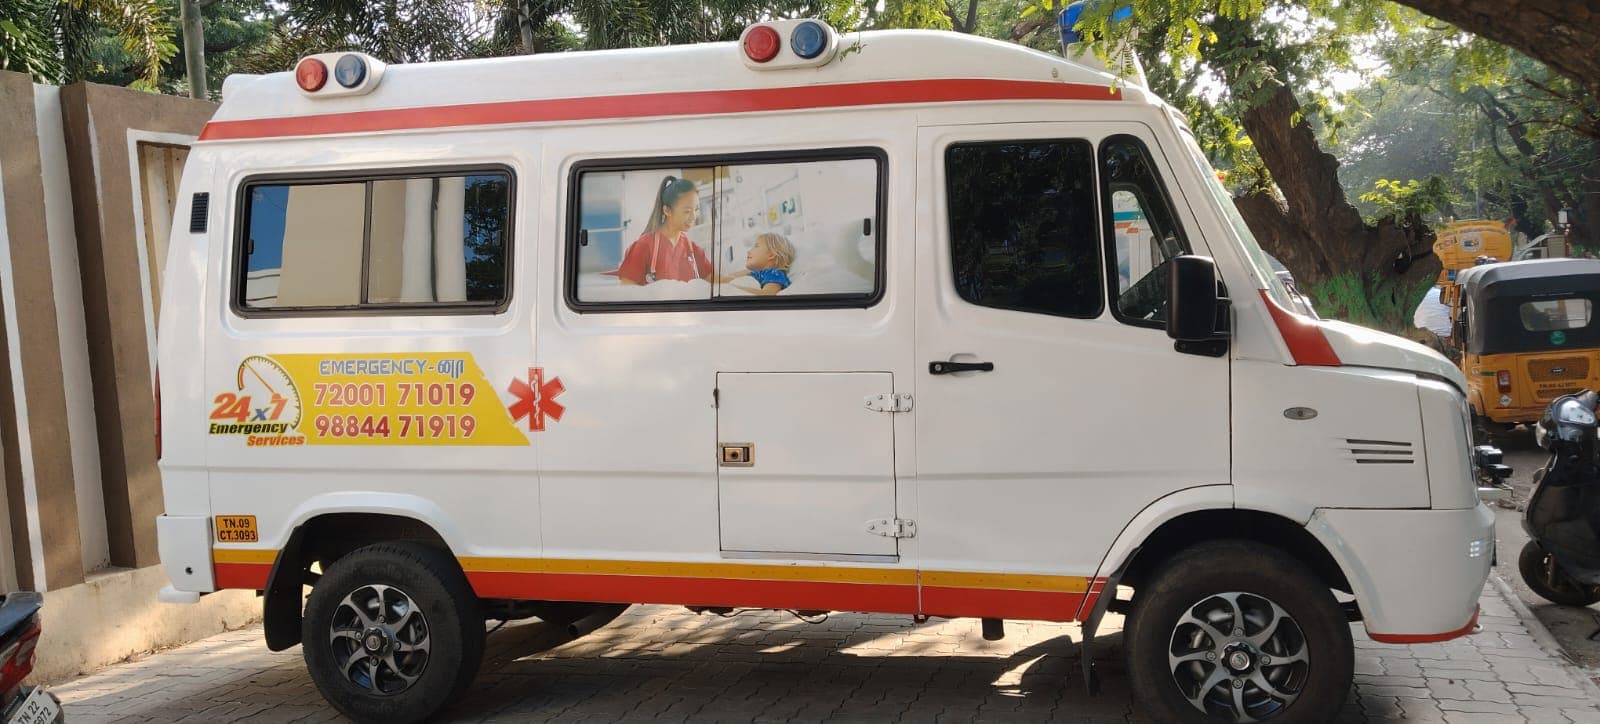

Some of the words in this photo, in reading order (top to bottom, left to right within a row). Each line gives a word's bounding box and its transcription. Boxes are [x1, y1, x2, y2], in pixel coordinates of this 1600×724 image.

[314, 383, 386, 406] 72001
[397, 383, 475, 406] 71019
[209, 423, 289, 435] Emergency
[315, 415, 391, 438] 98844
[398, 415, 476, 438] 71919
[247, 435, 305, 446] Services
[223, 518, 250, 528] TN.09
[220, 530, 256, 540] CT.3093
[28, 701, 40, 715] 22
